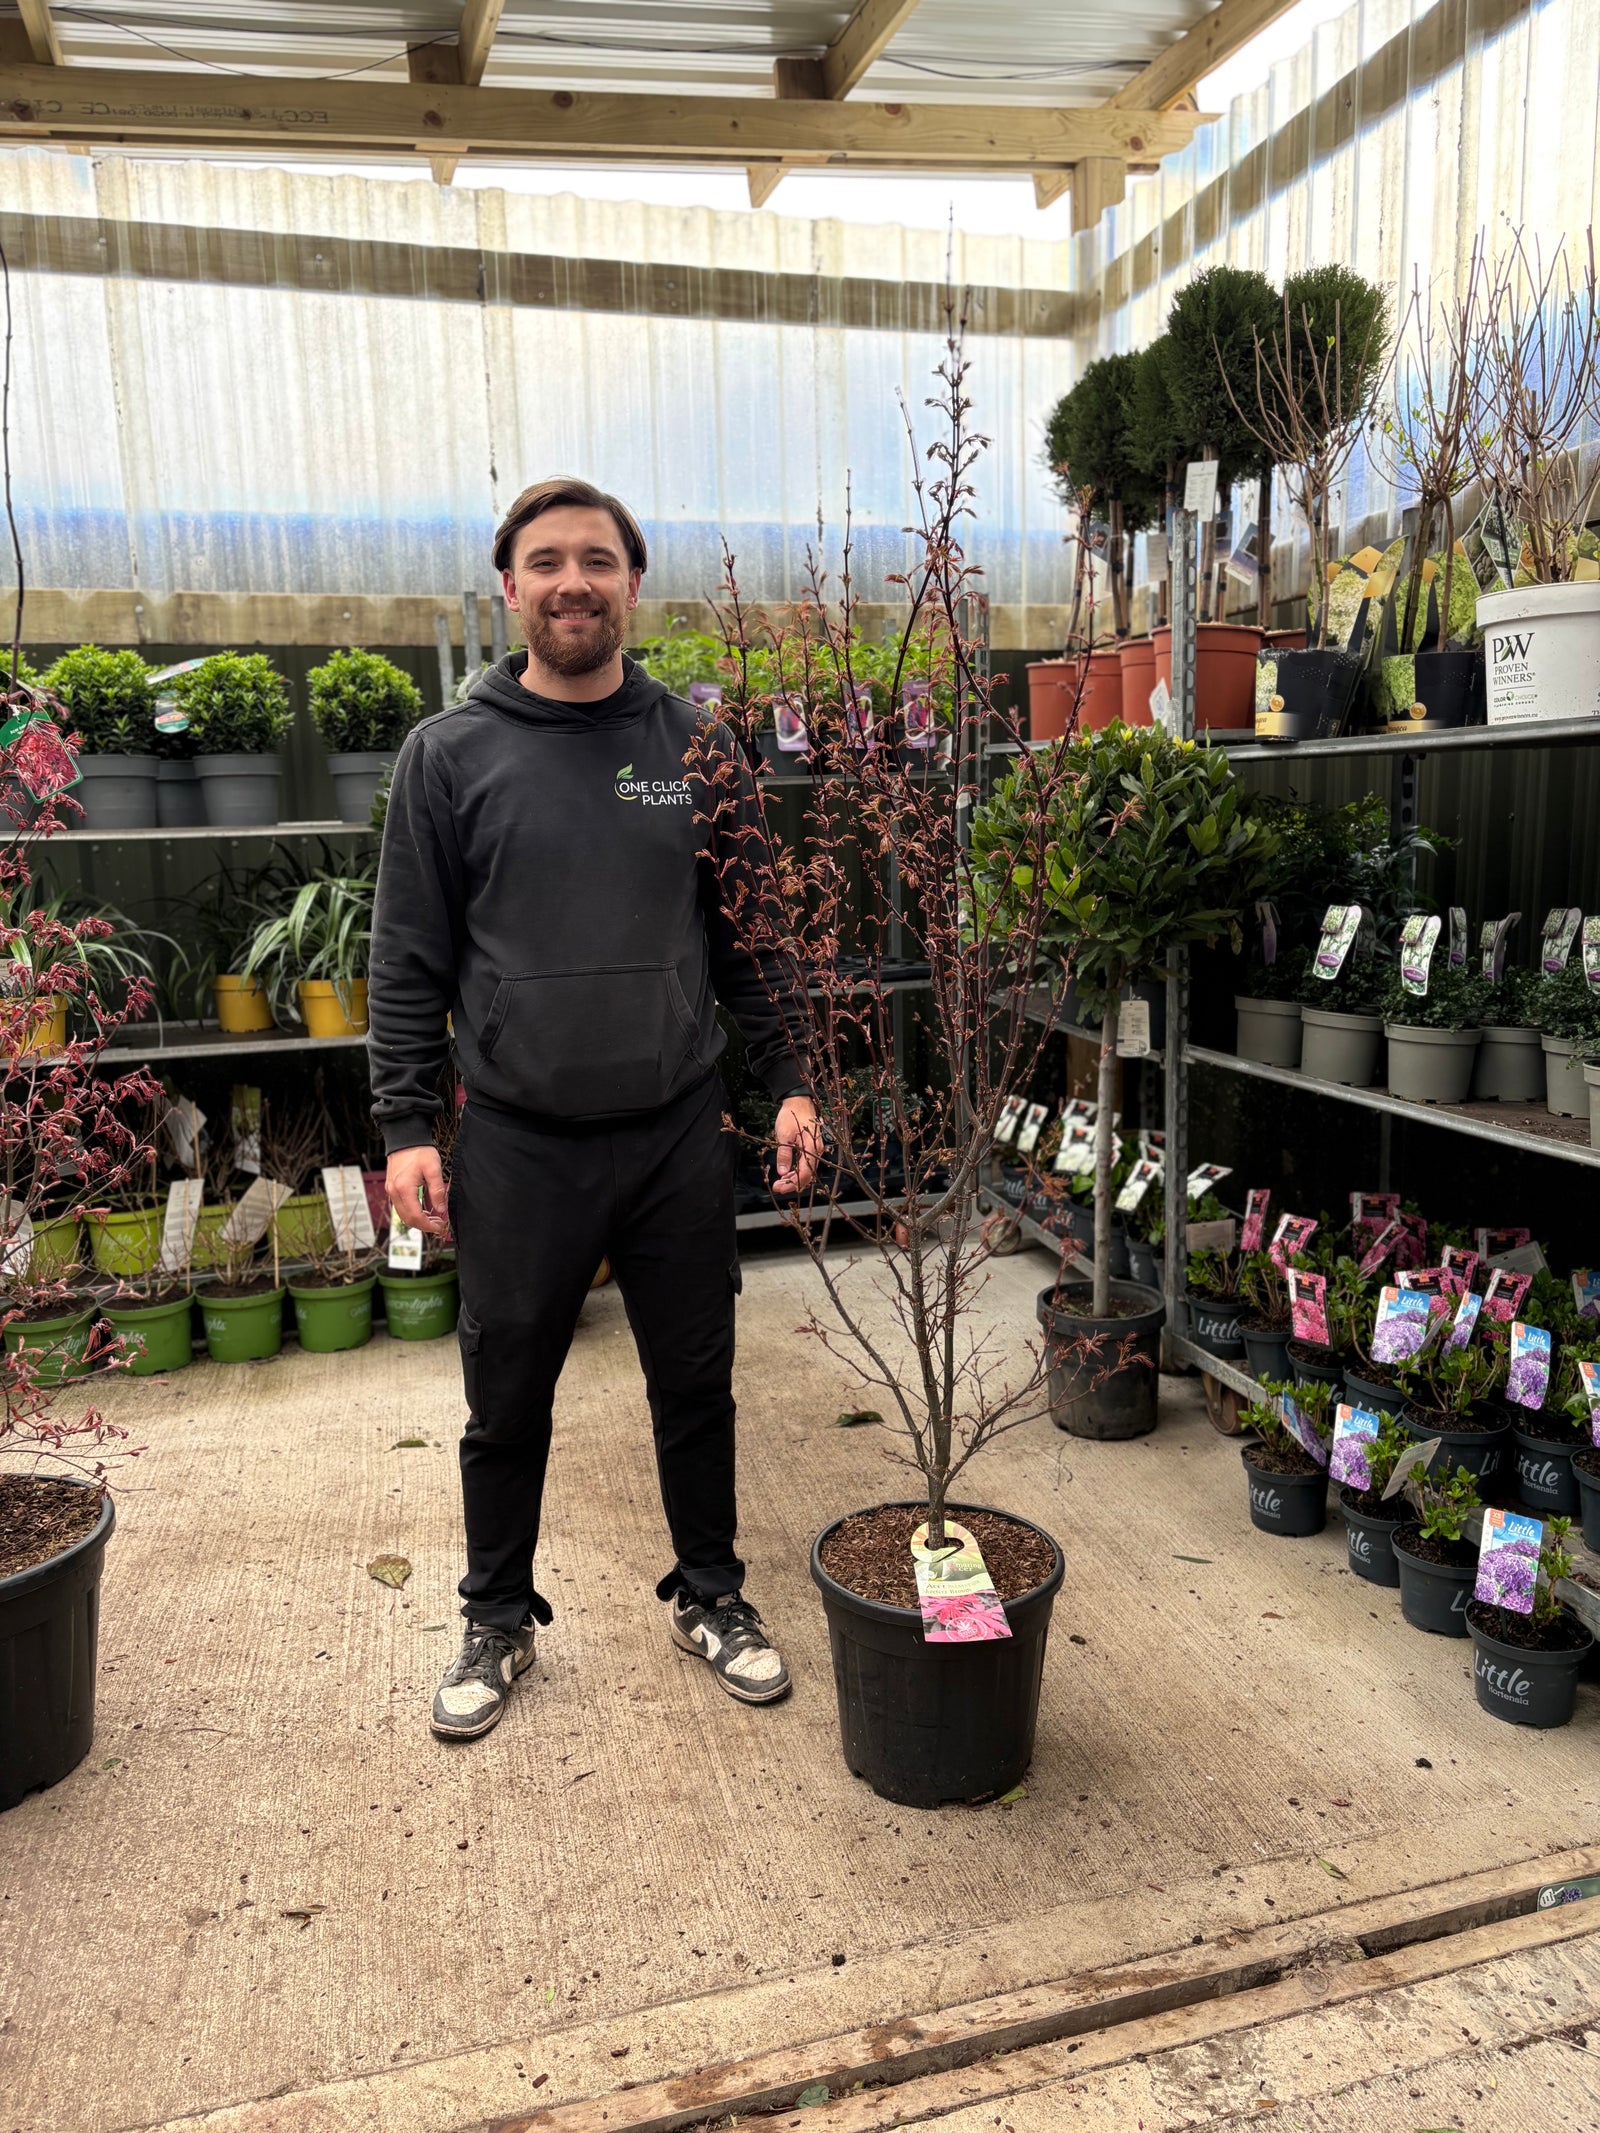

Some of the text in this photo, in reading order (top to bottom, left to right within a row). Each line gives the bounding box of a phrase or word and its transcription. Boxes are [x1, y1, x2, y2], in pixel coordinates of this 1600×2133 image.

[1492, 631, 1536, 665] PW
[1494, 662, 1529, 676] PROVEN
[619, 780, 692, 794] ONE CLICK
[642, 793, 693, 806] PLANTS
[1401, 1295, 1424, 1307] Little
[1527, 1331, 1546, 1345] Little
[1249, 1482, 1281, 1511] ittle
[1507, 1520, 1535, 1537] Little
[1474, 1648, 1531, 1696] Little
[1488, 1684, 1530, 1706] Hortensia
